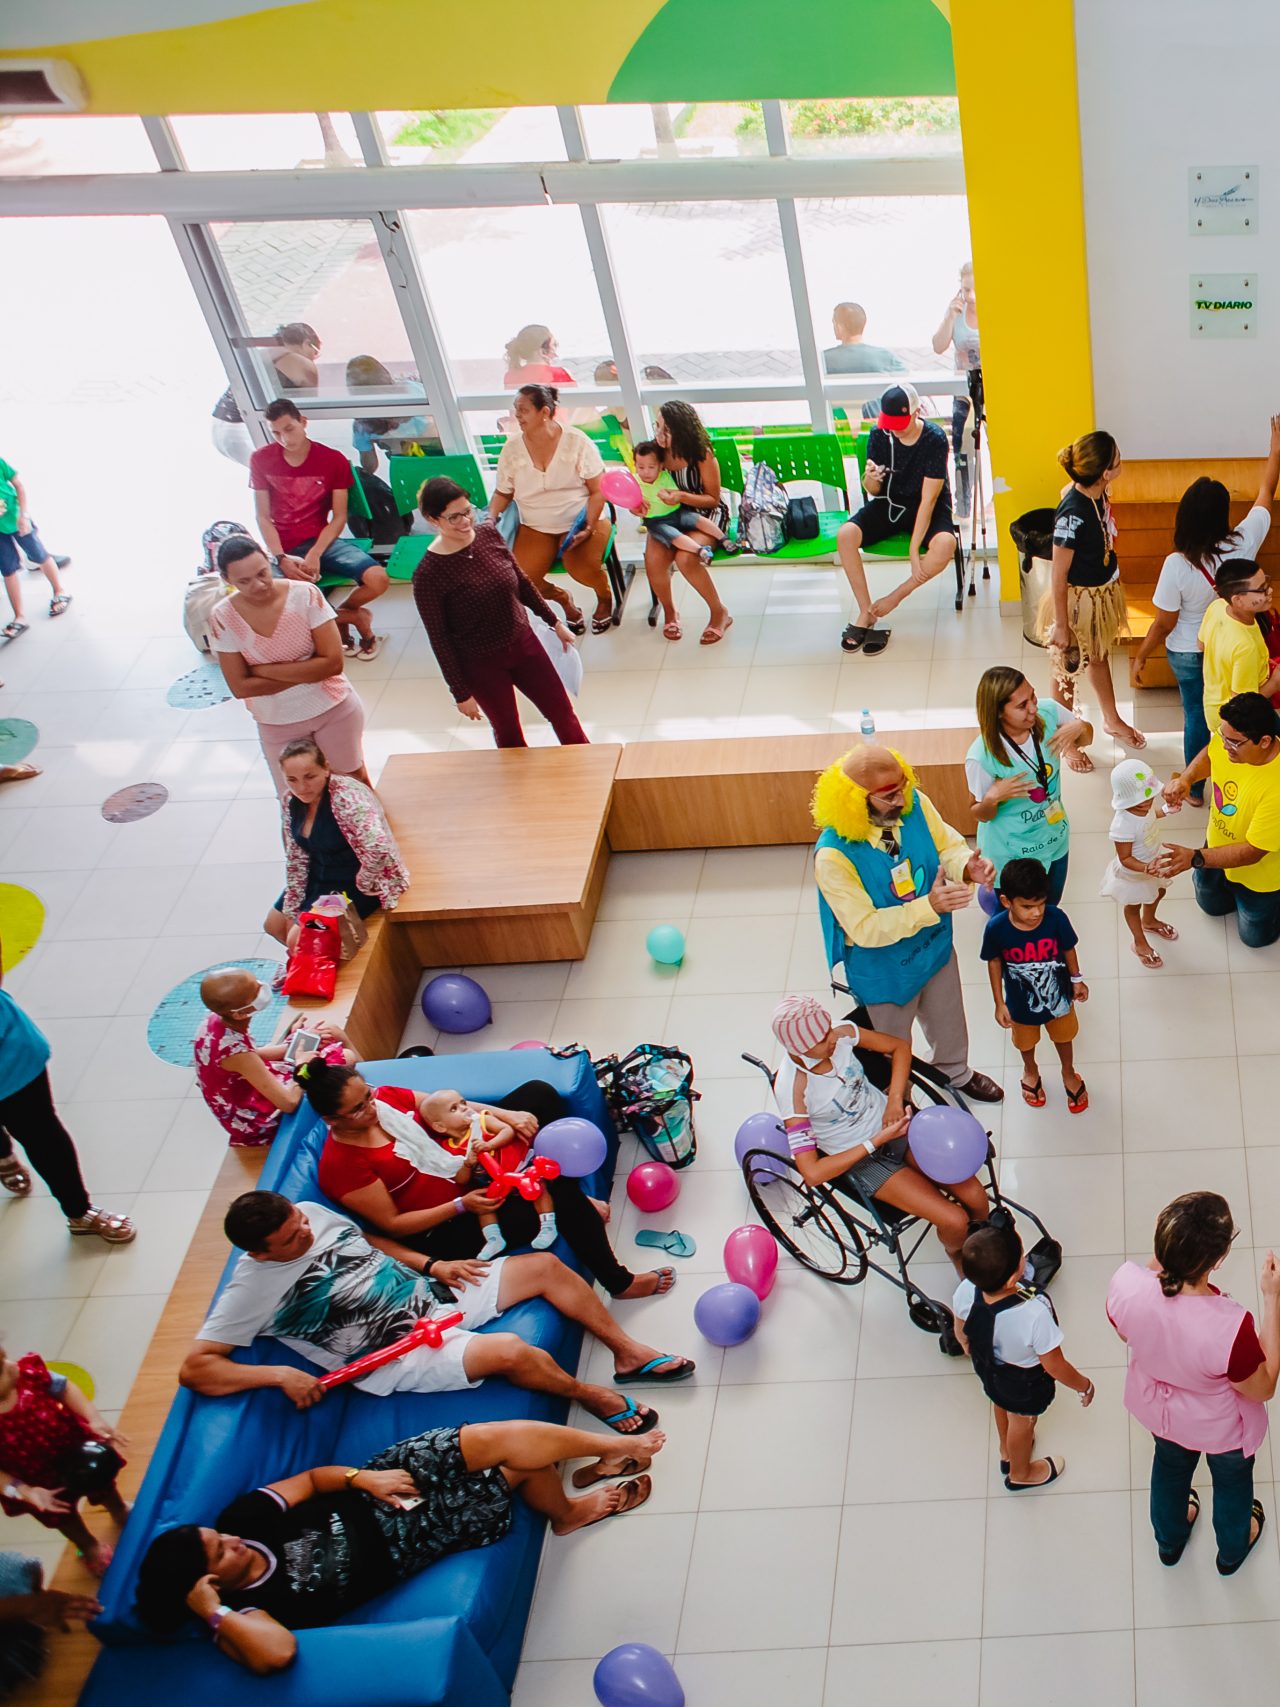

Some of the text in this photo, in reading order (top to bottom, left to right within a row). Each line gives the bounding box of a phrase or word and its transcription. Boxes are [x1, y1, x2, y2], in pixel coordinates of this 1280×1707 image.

[1195, 300, 1212, 310] TV
[1021, 843, 1045, 855] Raio
[1047, 836, 1058, 845] de
